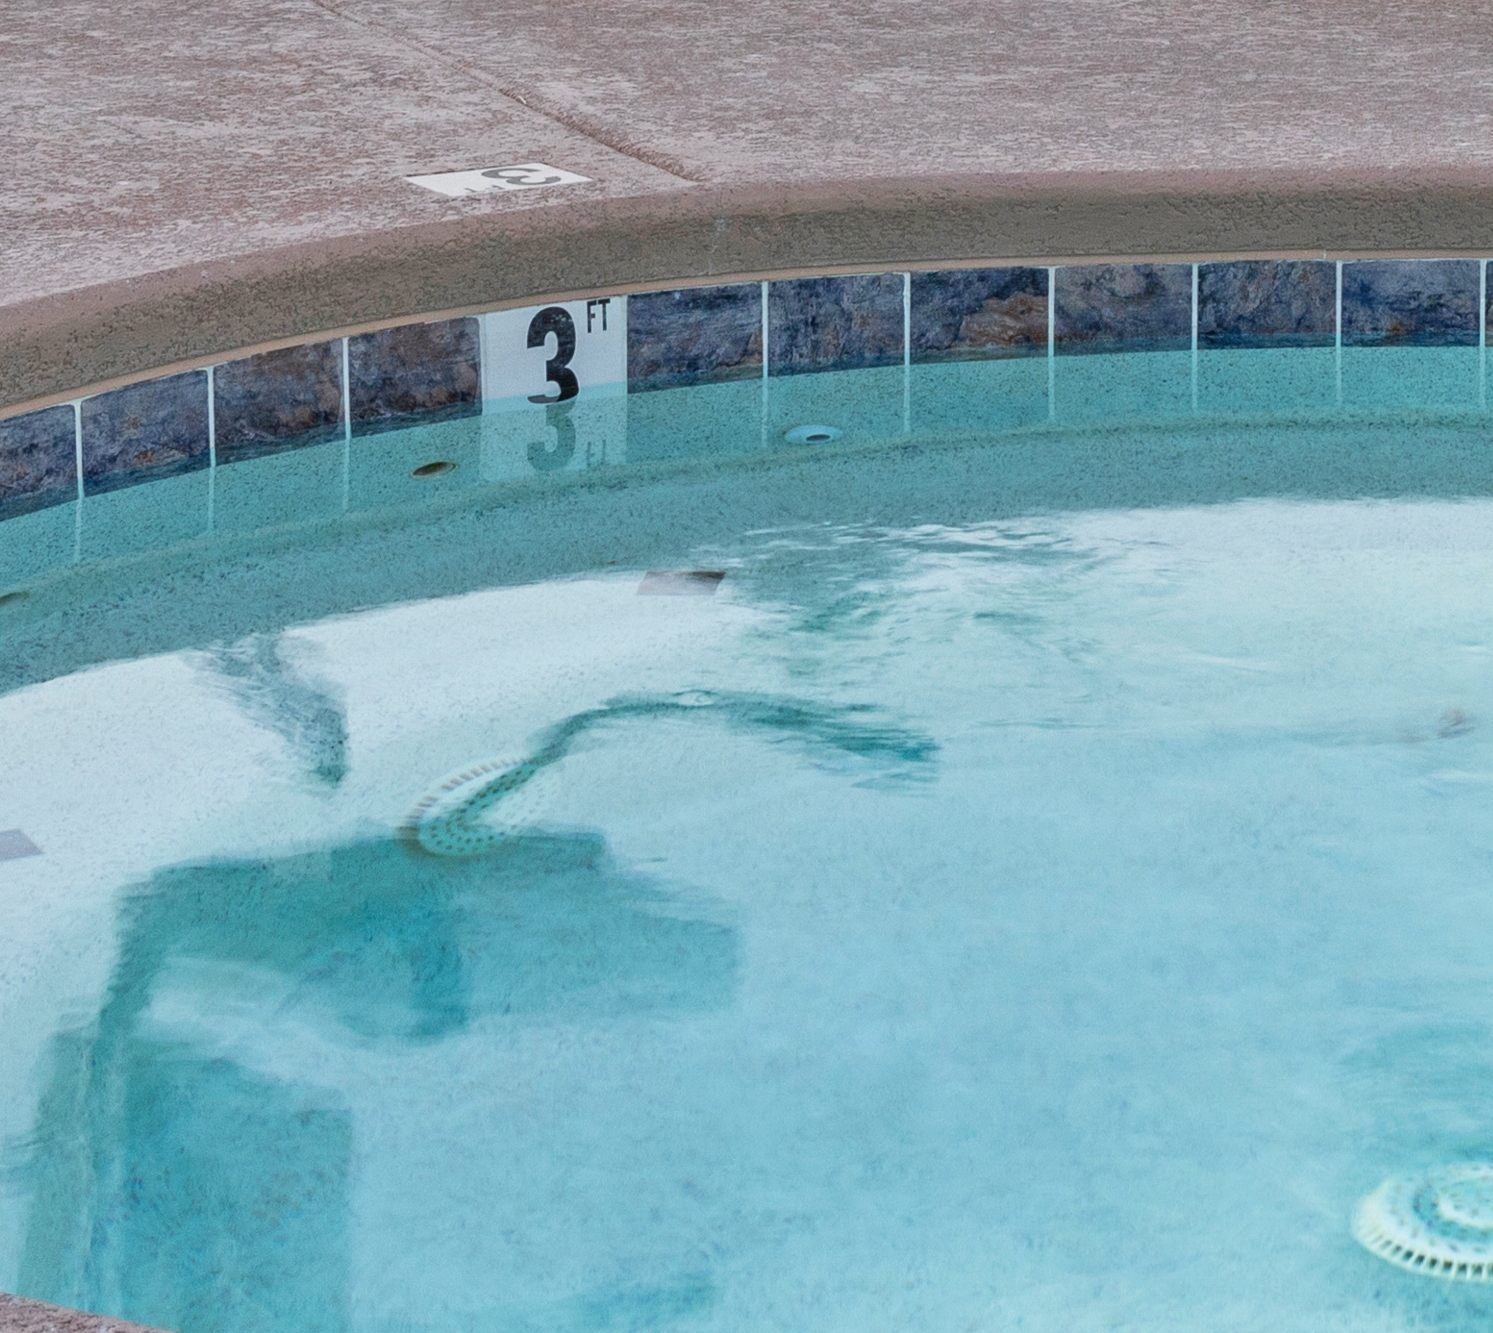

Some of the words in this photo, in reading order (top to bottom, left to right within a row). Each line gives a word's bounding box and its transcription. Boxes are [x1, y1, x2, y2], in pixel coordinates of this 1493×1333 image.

[481, 168, 562, 186] 3
[527, 306, 579, 404] 3
[586, 298, 611, 333] FT
